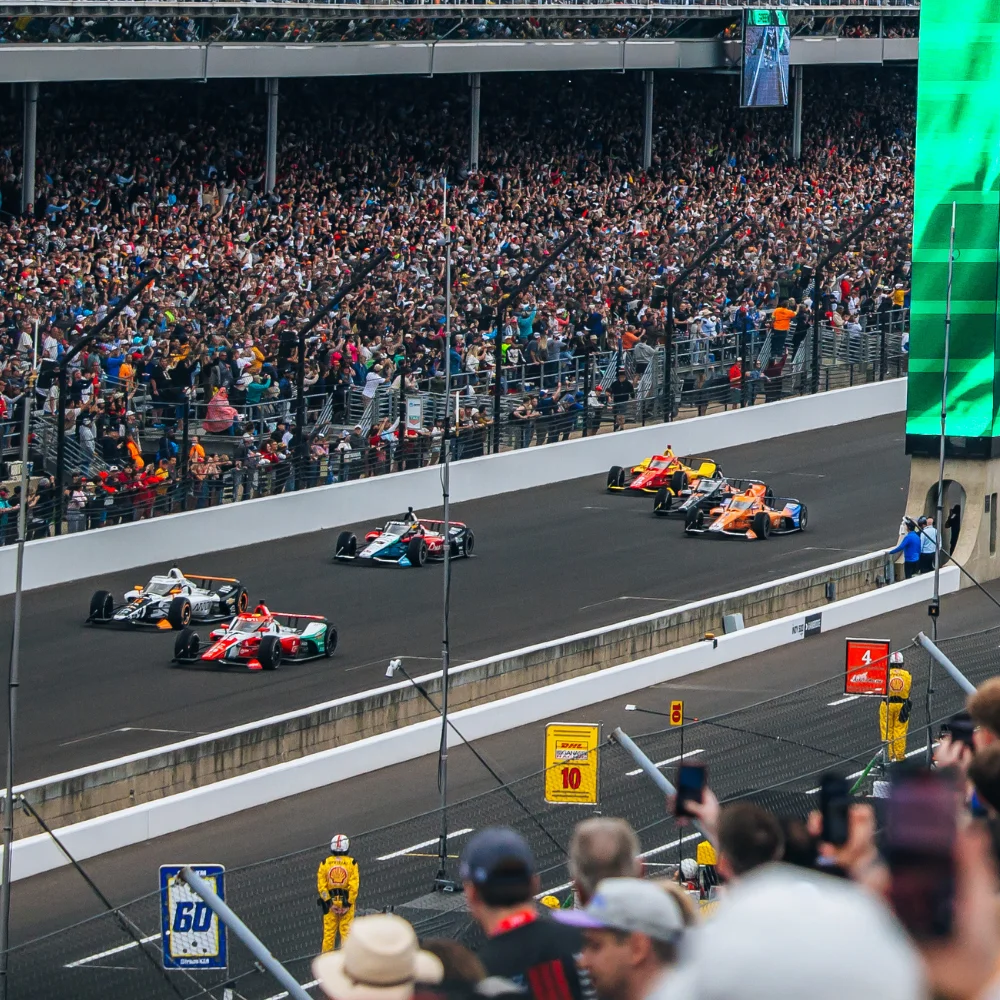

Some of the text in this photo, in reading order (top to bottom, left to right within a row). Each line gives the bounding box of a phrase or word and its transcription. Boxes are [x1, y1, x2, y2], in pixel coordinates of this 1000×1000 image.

[861, 649, 872, 666] 4
[672, 703, 681, 723] 10
[561, 767, 581, 790] 10
[173, 901, 213, 932] 60
